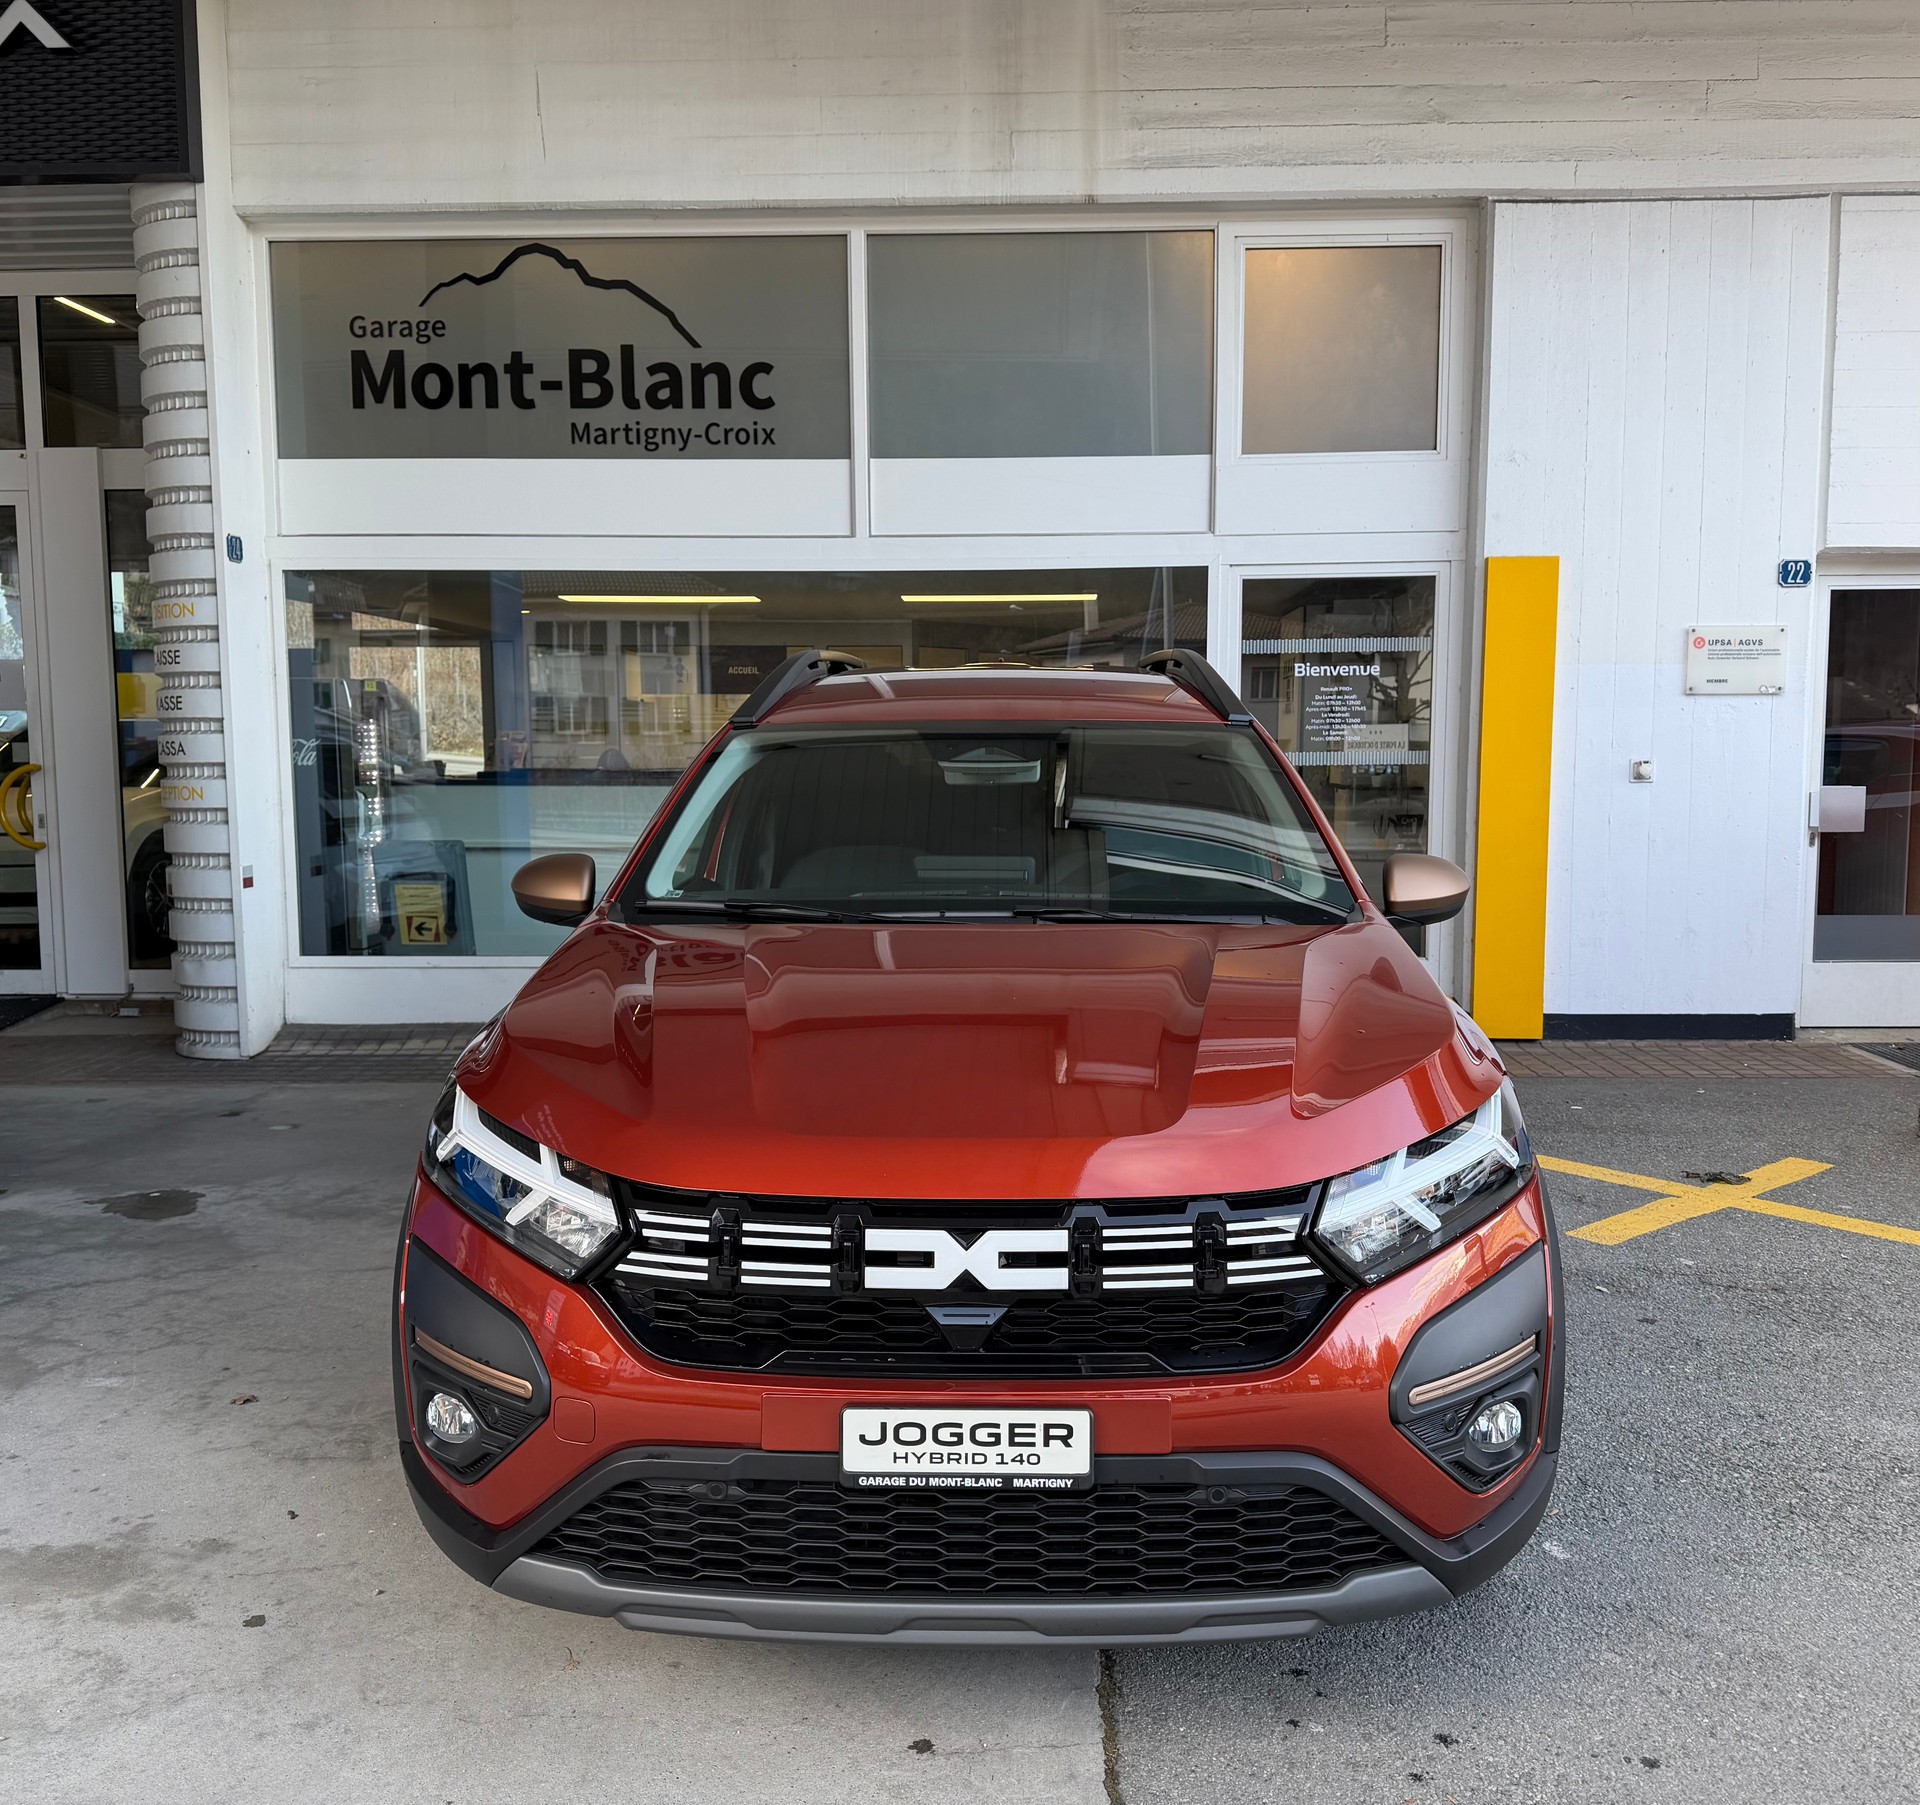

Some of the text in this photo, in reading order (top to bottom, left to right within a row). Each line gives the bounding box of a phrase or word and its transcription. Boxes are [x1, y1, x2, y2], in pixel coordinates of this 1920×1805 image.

[349, 315, 447, 345] Garage
[350, 344, 777, 411] Mont-Blanc
[570, 420, 777, 453] Martigny-Croix
[1787, 561, 1805, 584] 22
[154, 602, 195, 620] SITION
[155, 649, 181, 666] AISSE
[728, 666, 760, 674] ACCUEIL
[1294, 663, 1380, 677] Bienvenue
[159, 740, 186, 756] ASSA
[858, 1421, 1074, 1448] JOGGER
[893, 1452, 1041, 1466] HYBRID 140
[858, 1476, 1074, 1489] GARAGE DU MONT-BLANC MARTIGNY
